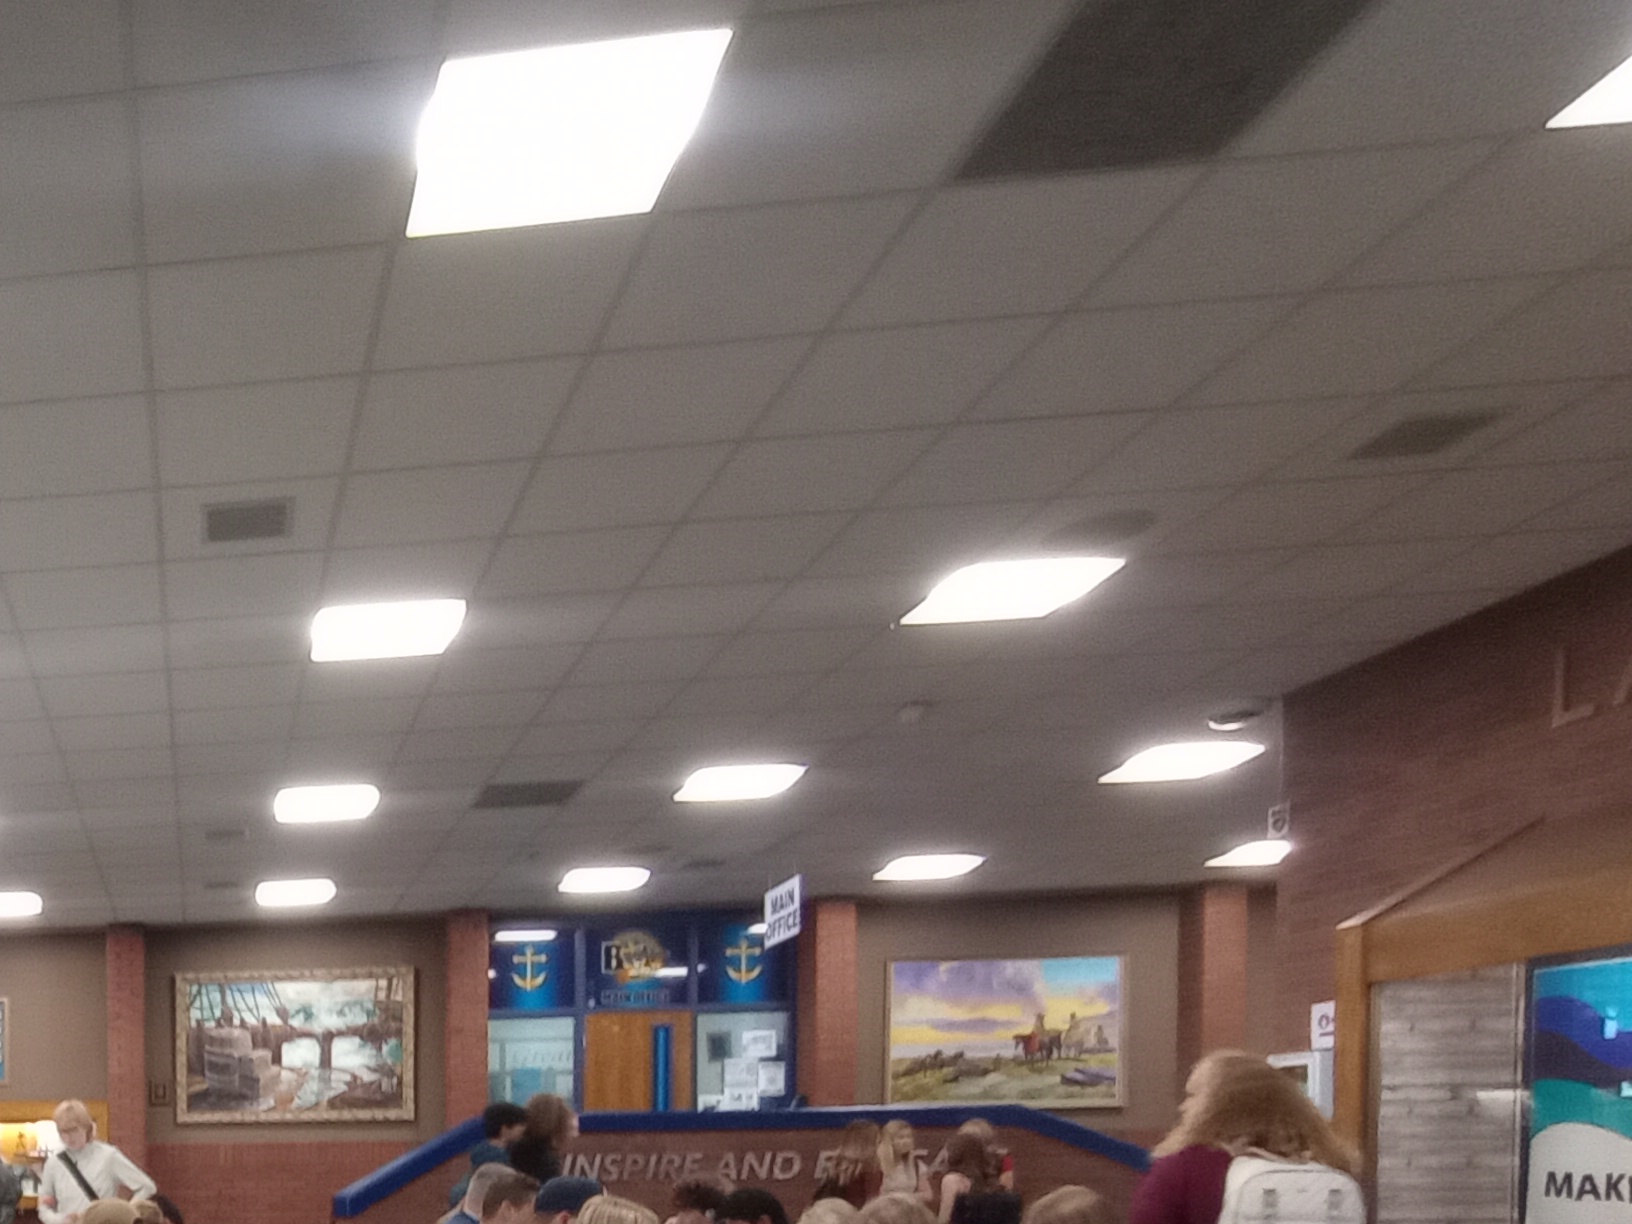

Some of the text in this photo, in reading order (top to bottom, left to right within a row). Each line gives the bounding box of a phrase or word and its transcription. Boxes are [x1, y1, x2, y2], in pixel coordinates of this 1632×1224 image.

[770, 887, 795, 915] MAIN
[765, 908, 798, 941] OFFICE
[562, 1151, 704, 1181] INSPIRE
[717, 1151, 802, 1181] AND
